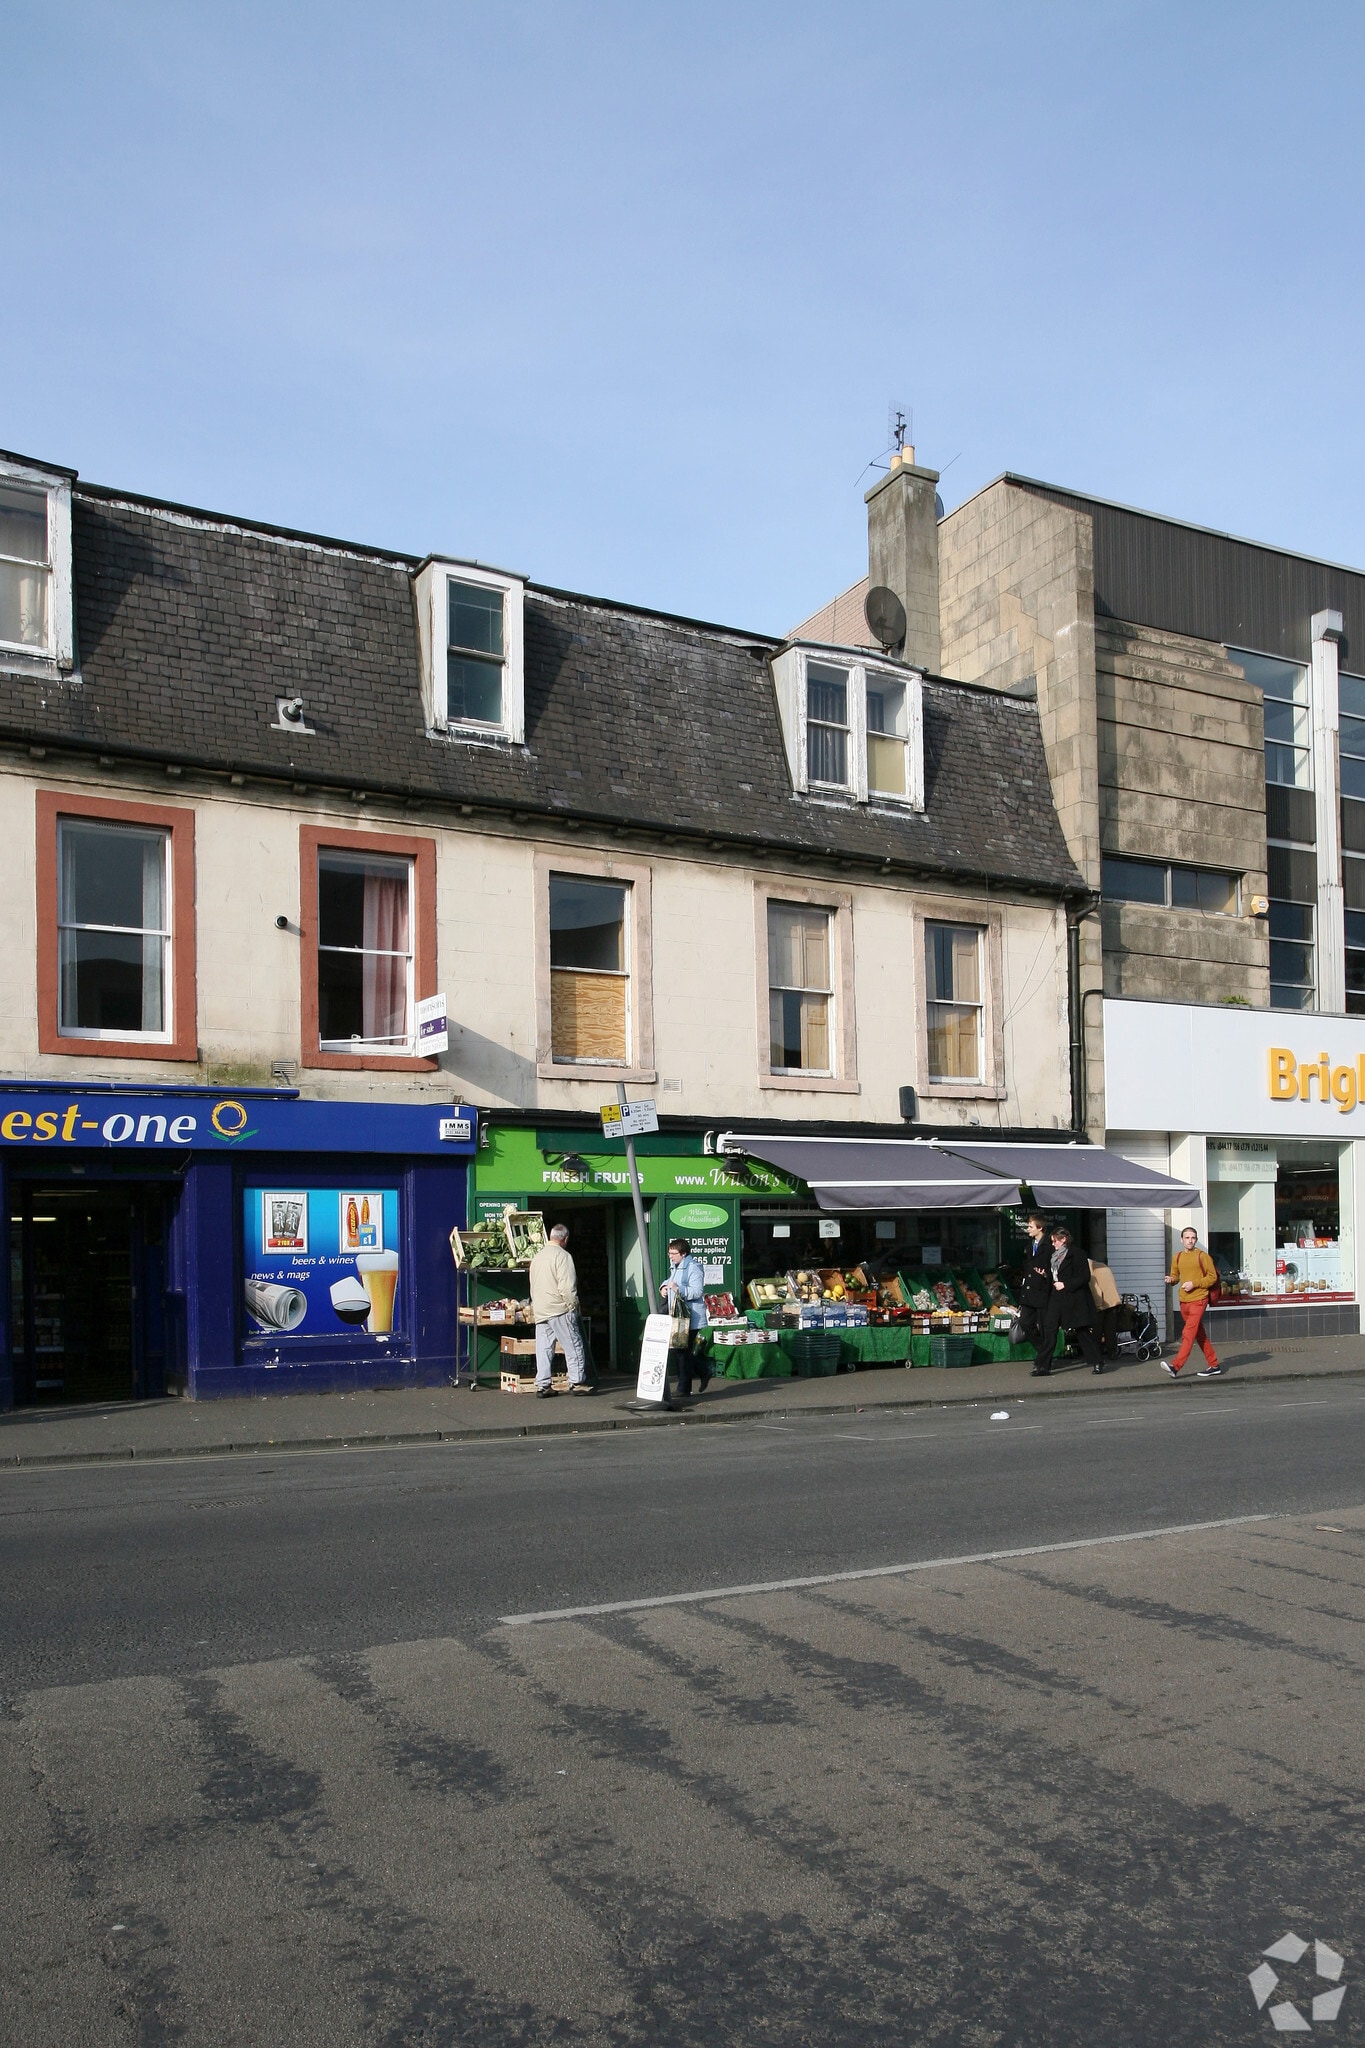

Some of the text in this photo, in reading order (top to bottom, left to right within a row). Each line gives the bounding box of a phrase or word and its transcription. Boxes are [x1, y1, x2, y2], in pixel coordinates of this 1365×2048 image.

[445, 1122, 470, 1130] IMMS
[542, 1171, 590, 1184] FRESH
[674, 1175, 708, 1185] www.
[691, 1237, 730, 1246] DELIVERY
[690, 1246, 703, 1254] rder
[291, 1254, 355, 1266] beers & wines
[712, 1256, 732, 1265] 0772
[251, 1270, 311, 1282] news & mags
